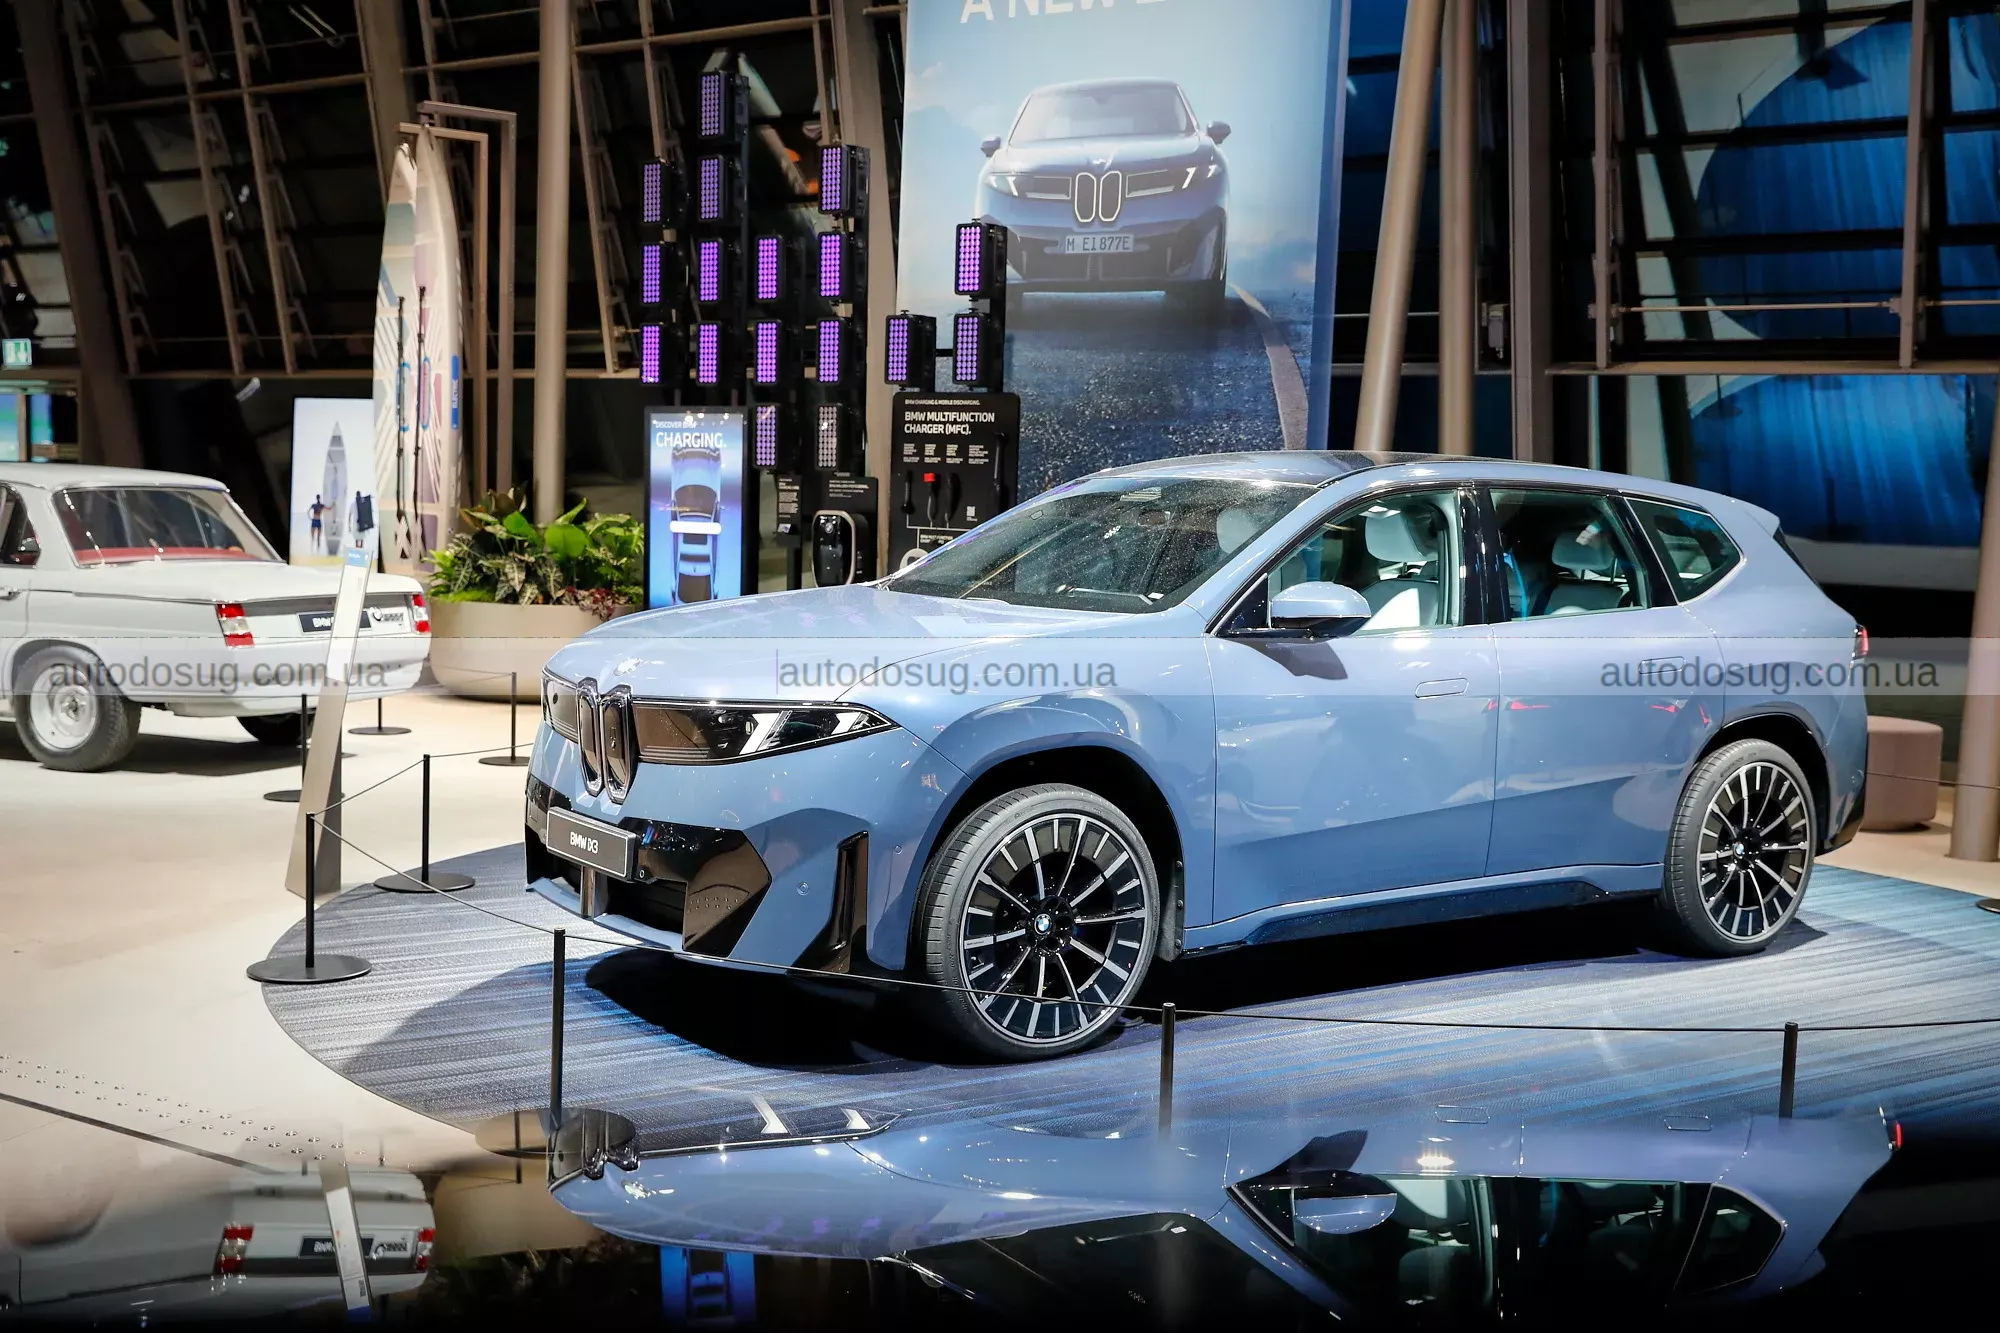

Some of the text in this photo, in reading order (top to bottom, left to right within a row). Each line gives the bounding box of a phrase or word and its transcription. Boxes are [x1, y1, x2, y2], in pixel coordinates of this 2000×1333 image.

[1066, 237, 1075, 252] M
[904, 411, 995, 422] BMW MULTIFUNCTION
[655, 420, 682, 429] DISCOVER
[904, 423, 972, 435] CHARGER (MFC).
[655, 431, 727, 448] CHARGING.
[570, 832, 587, 850] BMW
